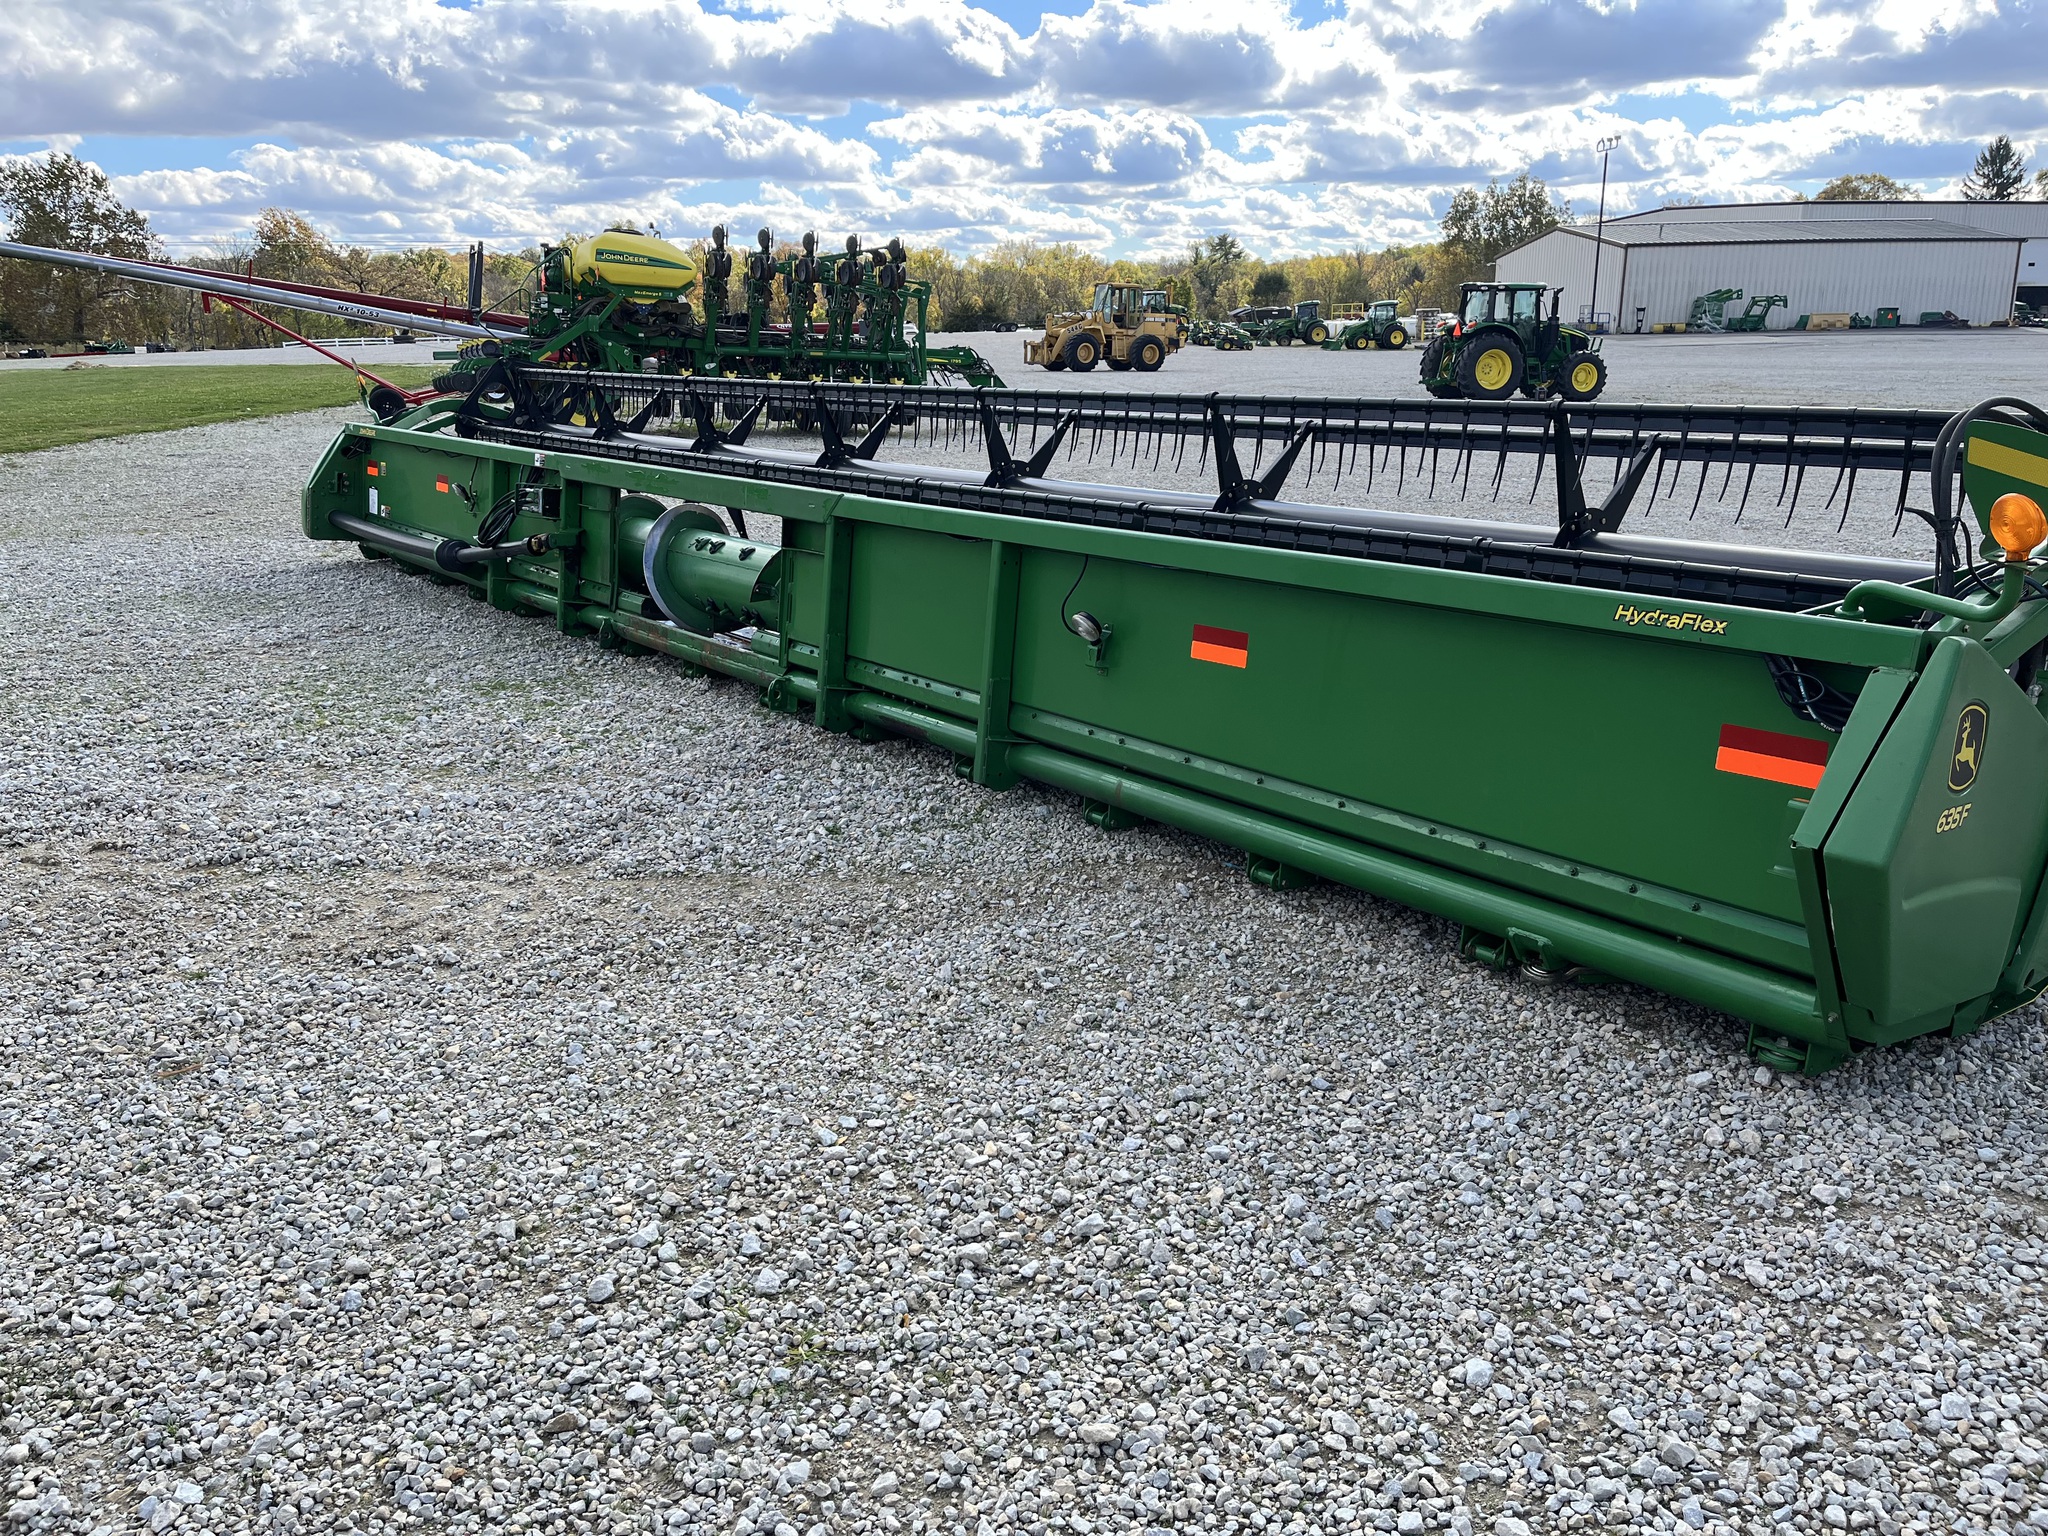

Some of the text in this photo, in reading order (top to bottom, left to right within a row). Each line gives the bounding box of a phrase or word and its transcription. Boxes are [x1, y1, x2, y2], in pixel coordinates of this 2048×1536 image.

[601, 252, 649, 264] JOHN DEERE
[1613, 603, 1730, 636] HydraFlex
[1936, 802, 1972, 834] 635F
